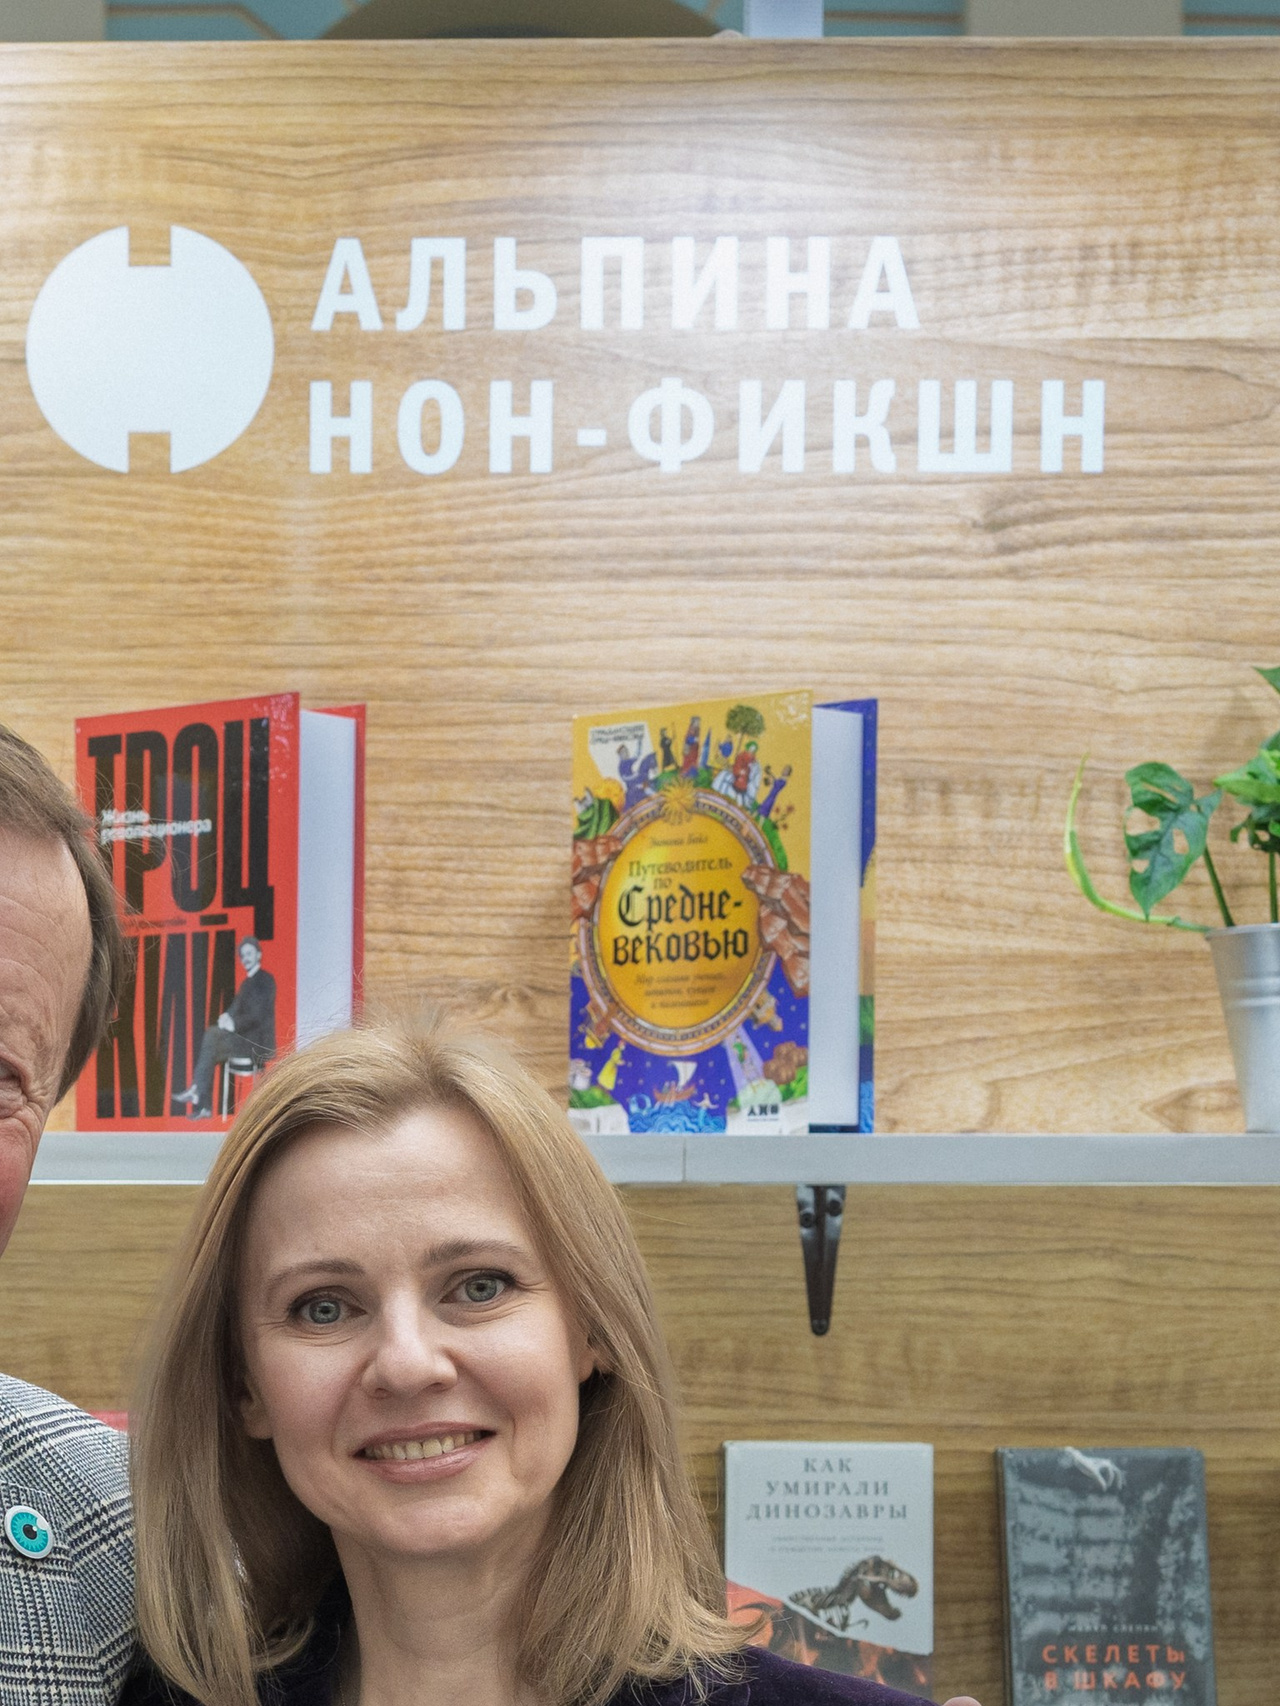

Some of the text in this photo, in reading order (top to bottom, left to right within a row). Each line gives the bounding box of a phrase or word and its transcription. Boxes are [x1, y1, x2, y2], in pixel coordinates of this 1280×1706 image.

[311, 235, 921, 332] АЛЬПИНА
[310, 378, 1106, 475] НОН-ФИКШН
[101, 809, 150, 824] Жизнь
[88, 717, 275, 940] ТРОЦ
[101, 818, 212, 845] революционера
[628, 857, 733, 881] Путеводитель
[654, 877, 672, 890] по
[618, 884, 743, 936] Средне-
[612, 926, 749, 966] вековью
[803, 1457, 853, 1474] КАК
[766, 1480, 890, 1497] УМИРАЛИ
[746, 1502, 908, 1521] ДИНОЗАВРЫ
[1042, 1644, 1186, 1664] СКЕЛЕТЫ
[1045, 1670, 1188, 1691] В ШКАФУ
